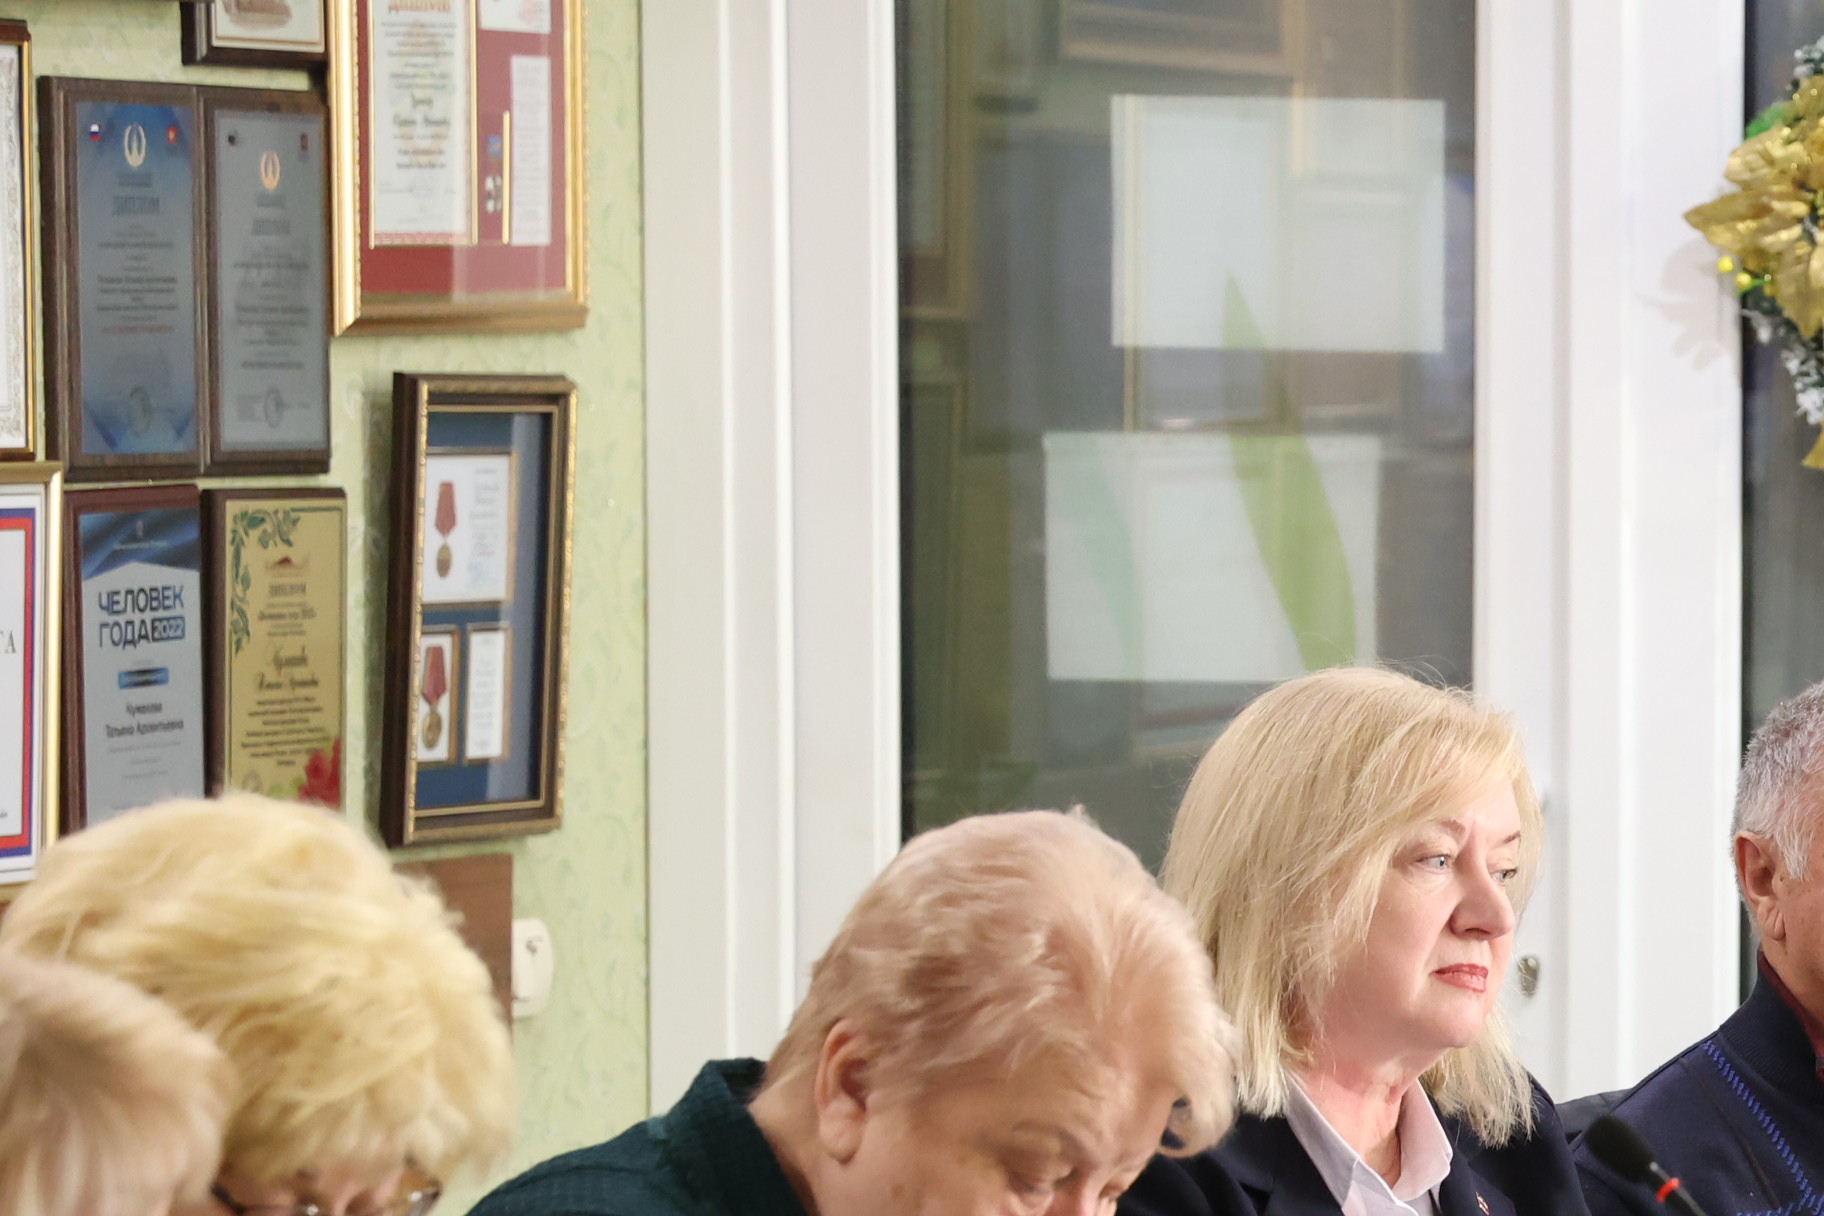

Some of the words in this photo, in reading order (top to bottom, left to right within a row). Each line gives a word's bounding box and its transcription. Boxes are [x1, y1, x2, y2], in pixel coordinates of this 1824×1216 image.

[98, 585, 185, 616] ЧЕЛОВЕК
[99, 618, 150, 649] ГОДА
[153, 618, 185, 639] 2022
